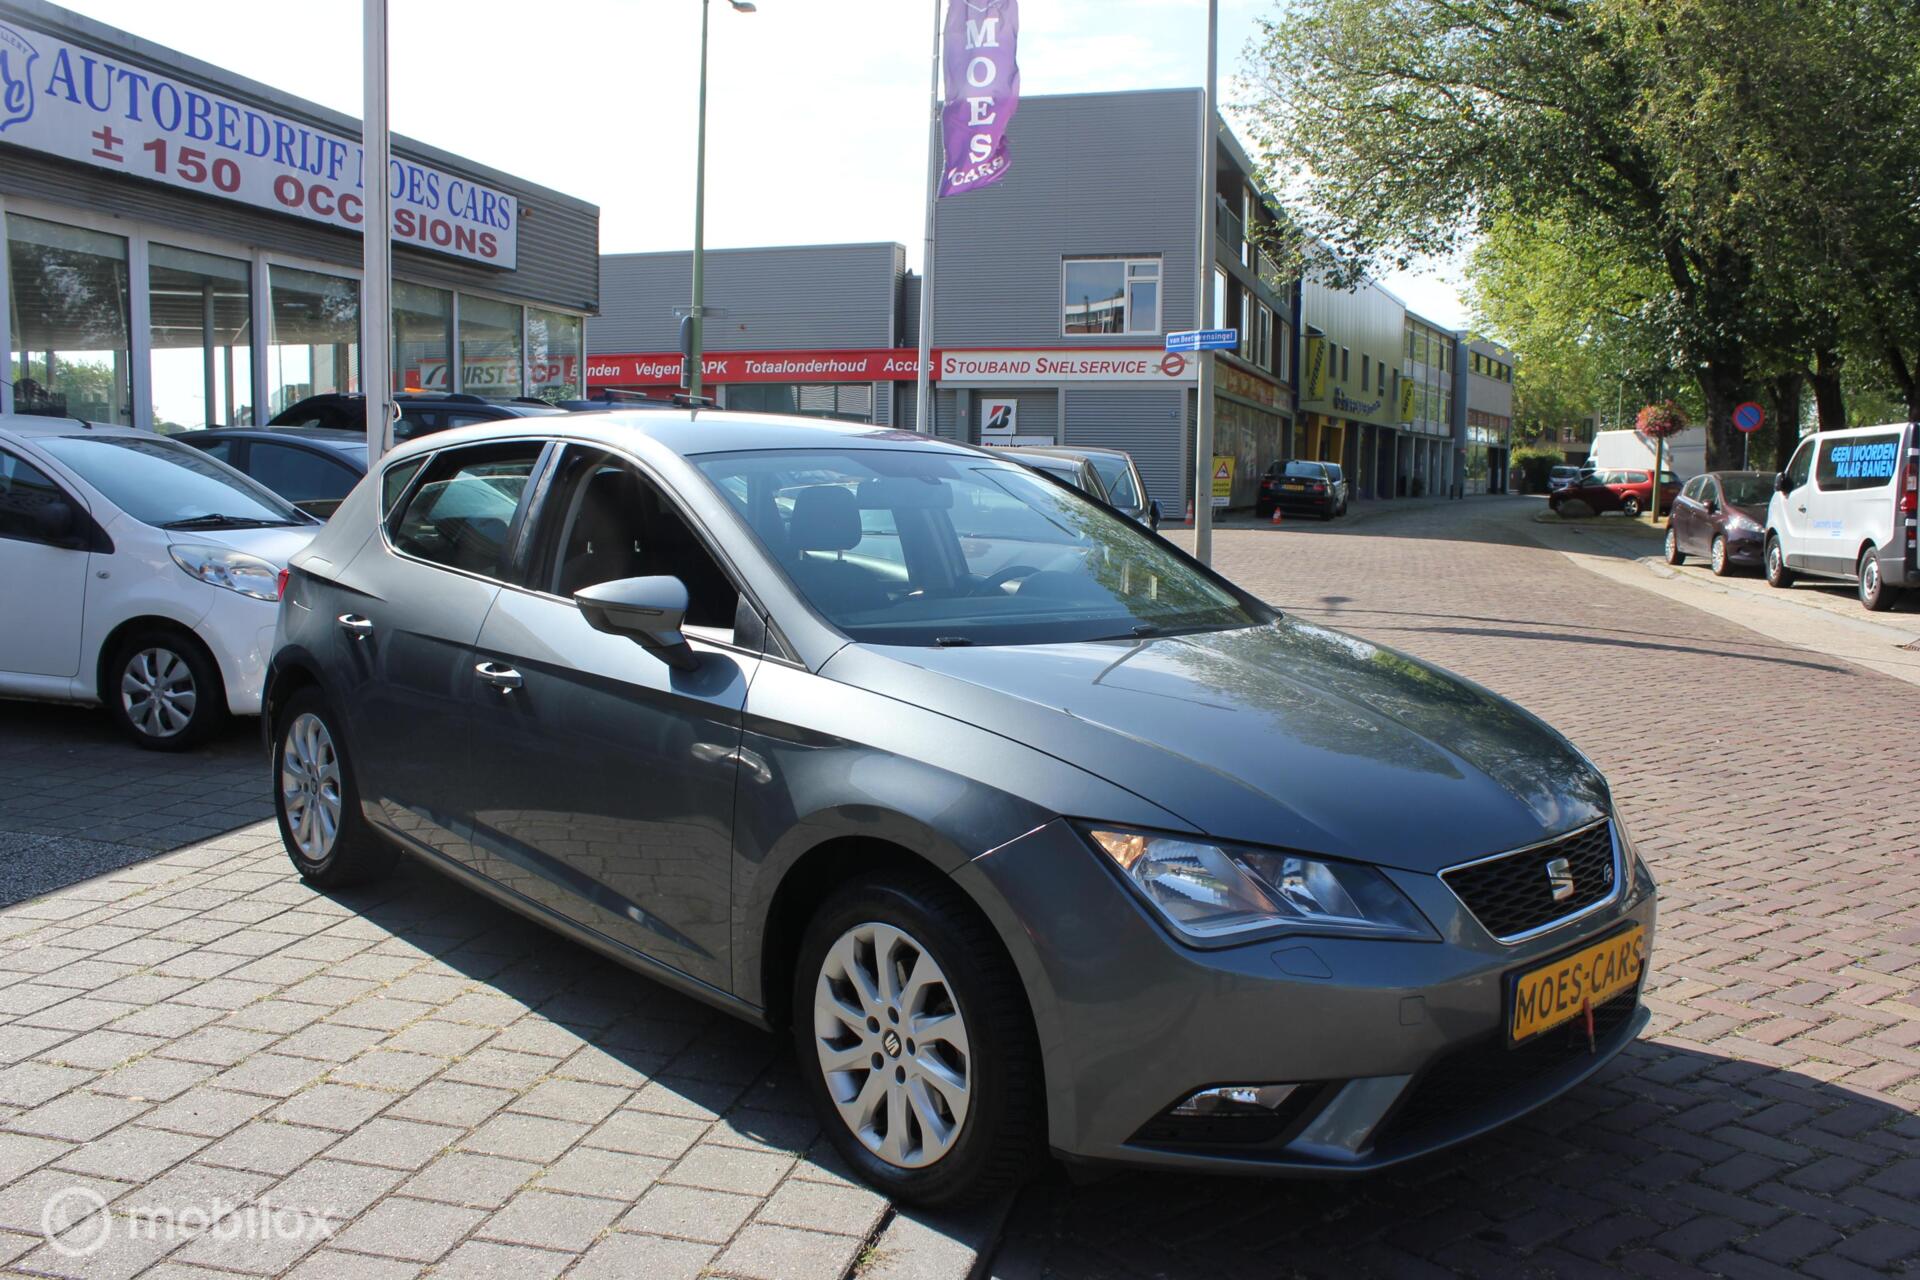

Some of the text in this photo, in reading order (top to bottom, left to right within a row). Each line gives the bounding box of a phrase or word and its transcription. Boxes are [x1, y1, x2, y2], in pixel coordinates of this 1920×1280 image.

[965, 17, 999, 164] MOES
[45, 48, 348, 181] AUTOBEDRIJF
[357, 148, 440, 210] OES
[447, 180, 511, 232] CARS
[952, 156, 1004, 186] CARS
[143, 138, 241, 193] 150
[273, 174, 498, 258] OCCSIONS
[569, 362, 621, 378] Bnden
[635, 361, 681, 379] Velgen
[744, 358, 867, 374] Totaalonderhoud
[944, 357, 1148, 374] STOUBAND SNELSERVICE
[1831, 443, 1897, 462] GEEN WOORDEN
[1836, 460, 1895, 478] MAAR BANEN
[1514, 934, 1643, 1030] MOES-CARS
